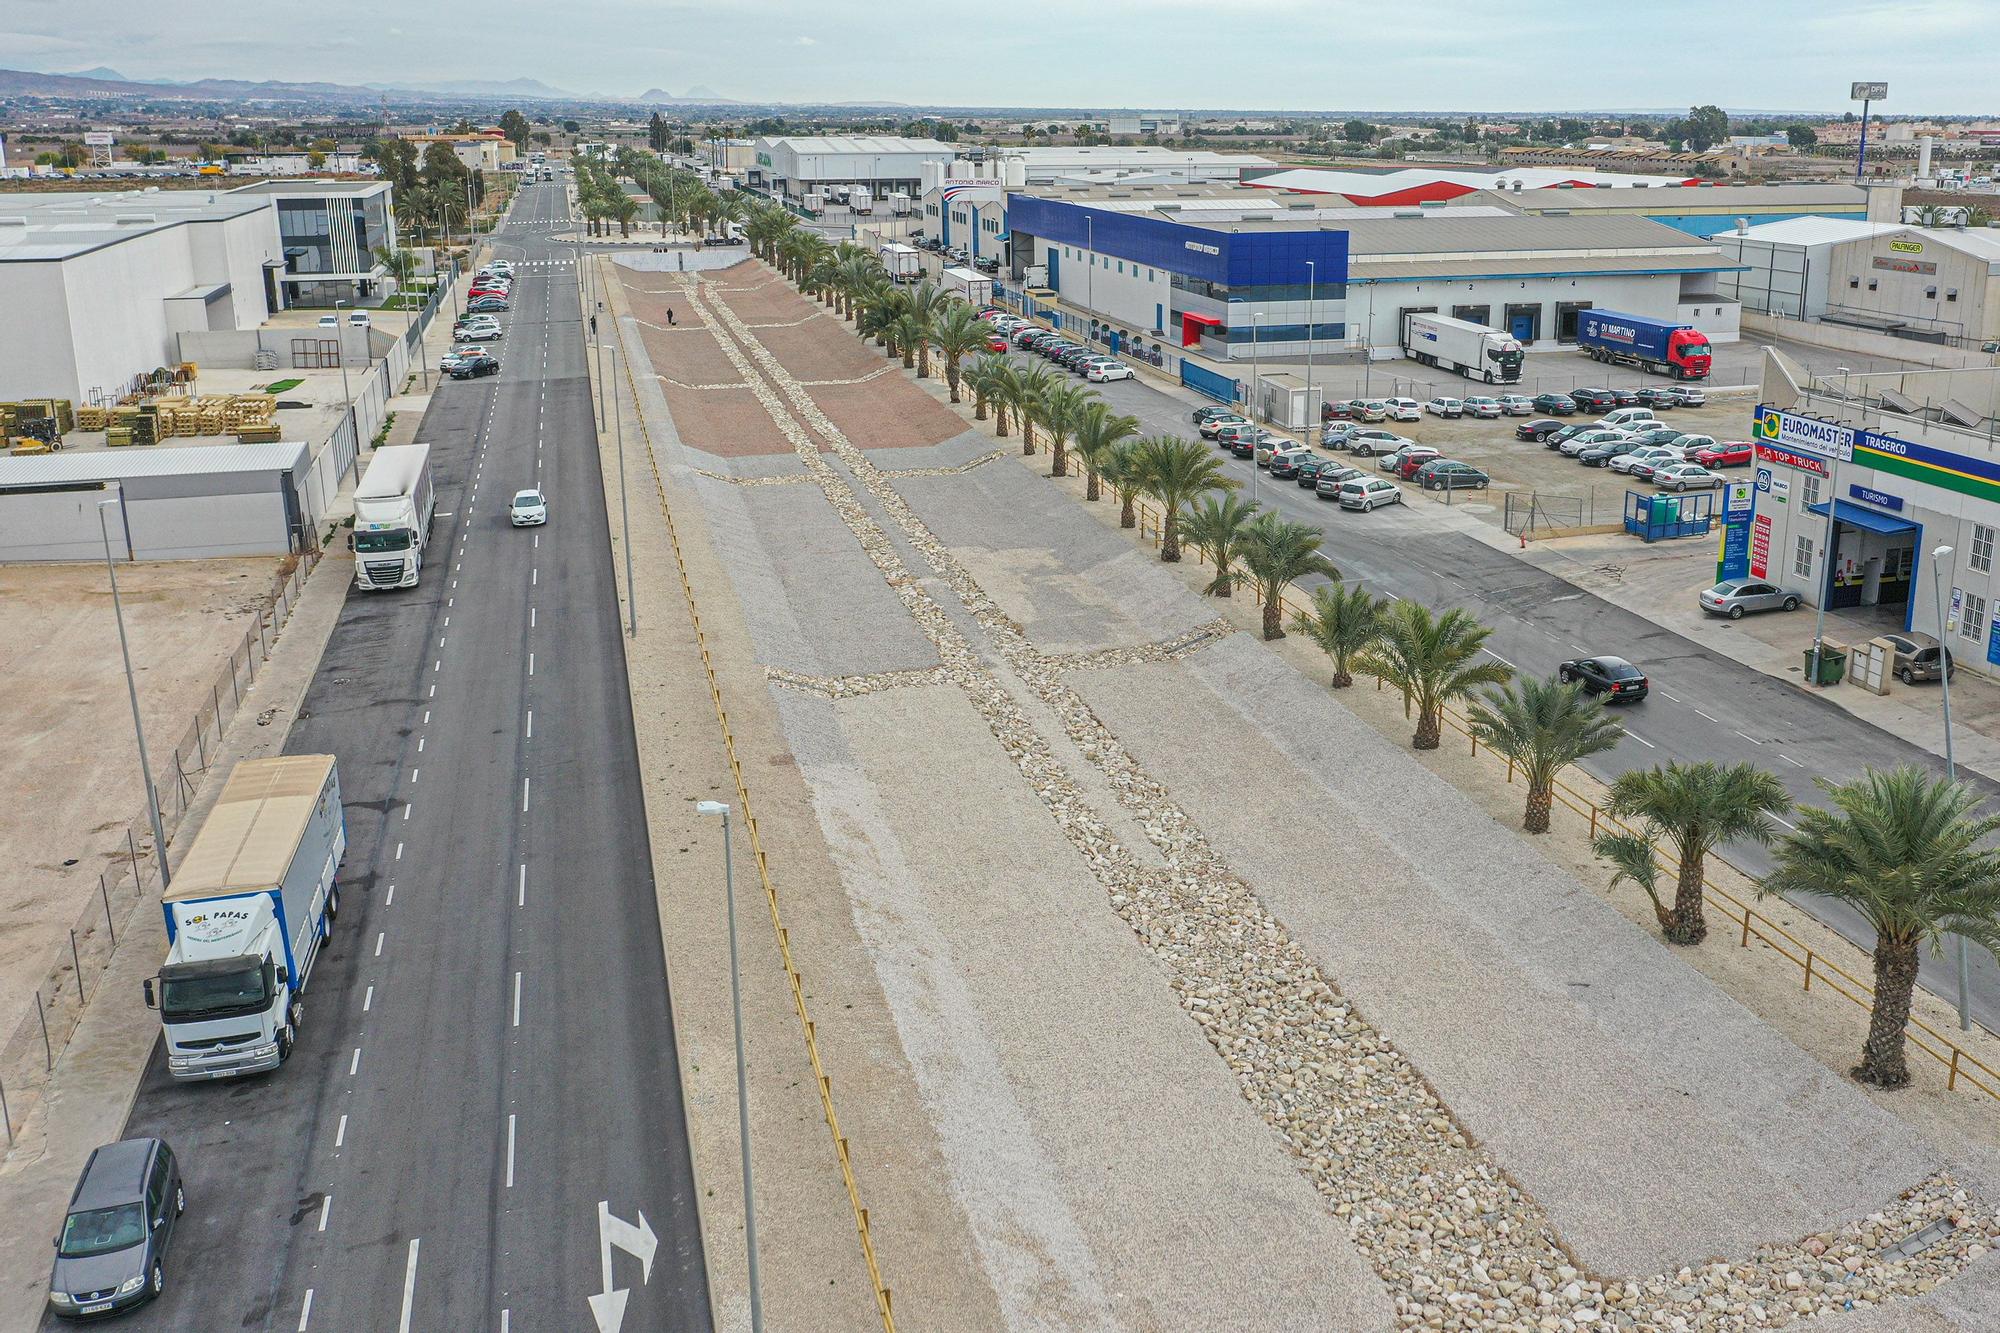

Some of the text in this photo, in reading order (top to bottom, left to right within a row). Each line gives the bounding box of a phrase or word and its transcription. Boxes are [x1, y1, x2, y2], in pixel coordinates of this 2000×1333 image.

[1891, 242, 1921, 252] PALFINGER
[1608, 324, 1636, 338] MARTINO
[1782, 418, 1852, 448] EUROMASTER
[1819, 442, 1827, 451] del
[1828, 446, 1850, 457] vehculo
[1865, 435, 1906, 454] TRASERCO
[1774, 450, 1822, 472] TOP TRUCK
[1862, 490, 1888, 504] TURISMO
[185, 912, 248, 926] SOL PAPAS
